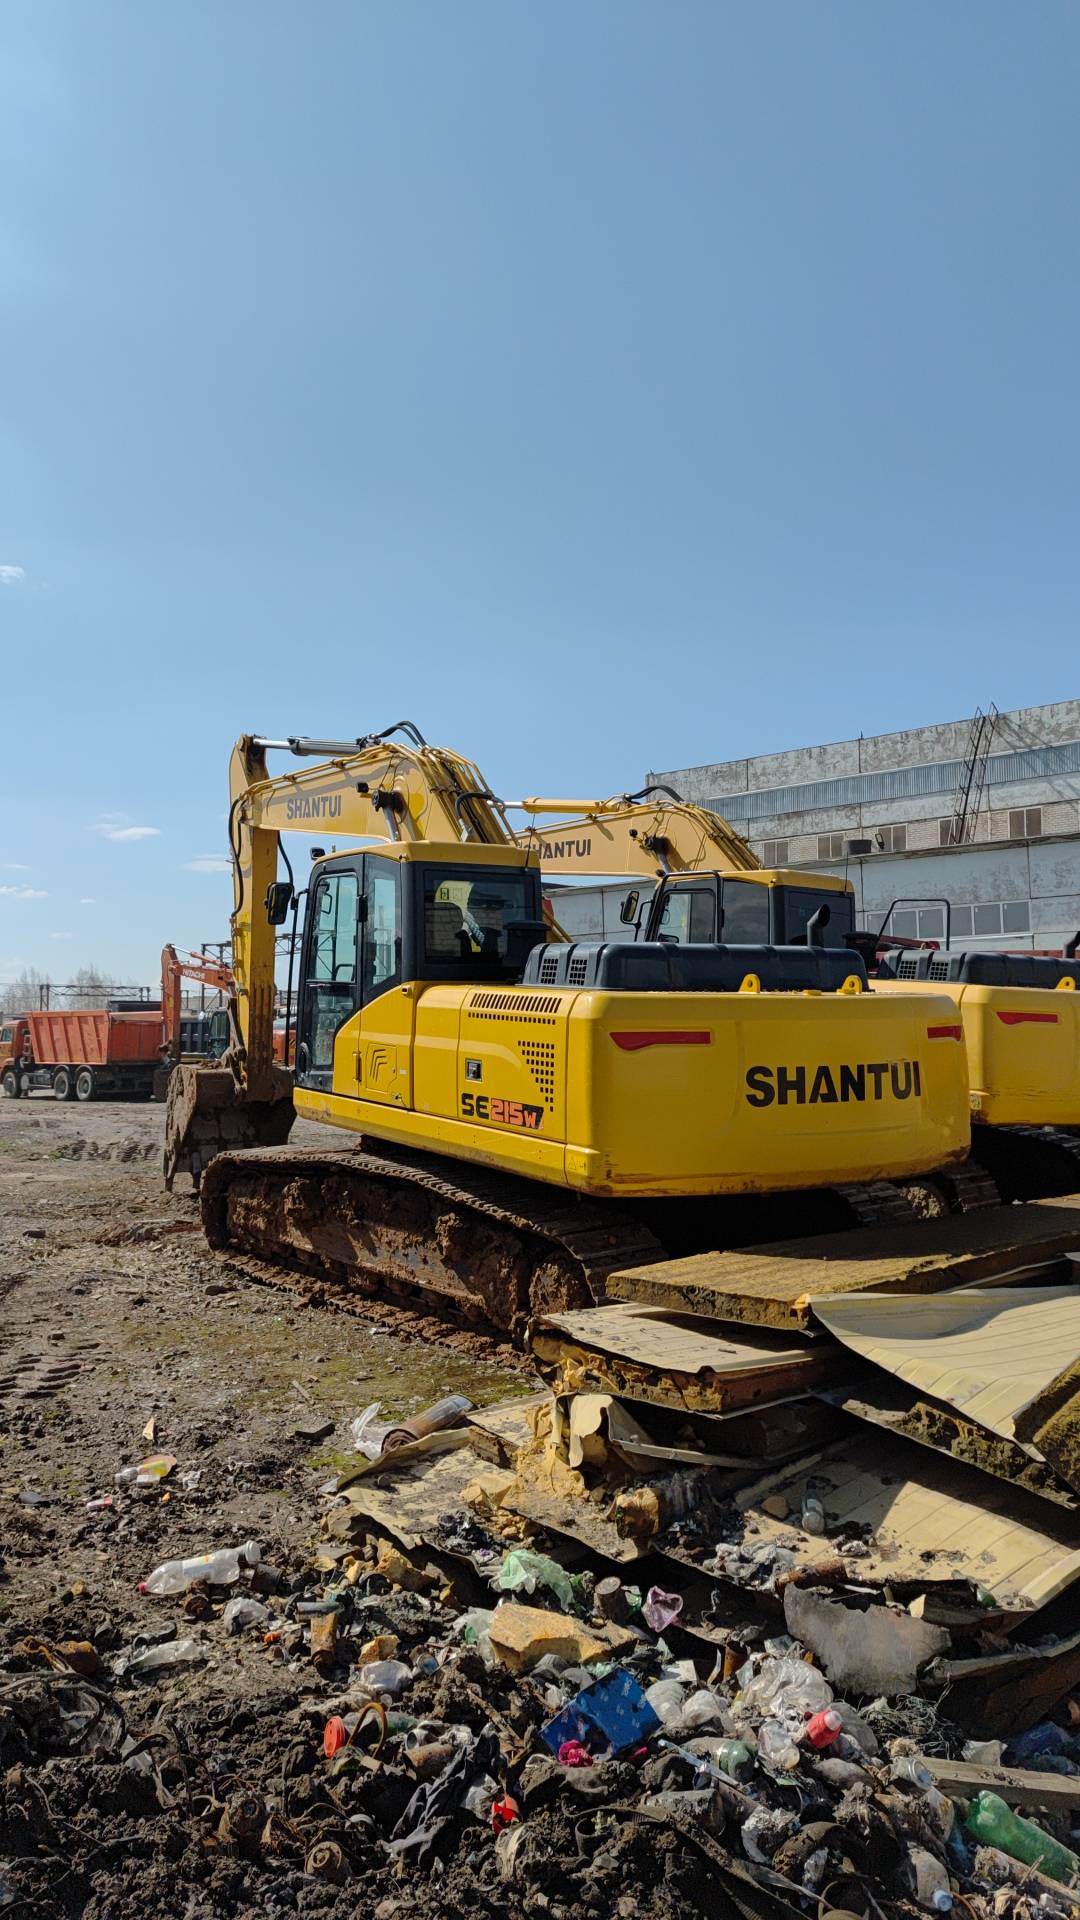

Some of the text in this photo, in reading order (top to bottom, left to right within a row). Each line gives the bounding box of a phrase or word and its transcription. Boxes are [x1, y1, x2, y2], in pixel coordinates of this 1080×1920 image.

[287, 795, 342, 820] SHANTUI
[524, 839, 592, 859] HANTUI
[745, 1060, 922, 1108] SHANTUI
